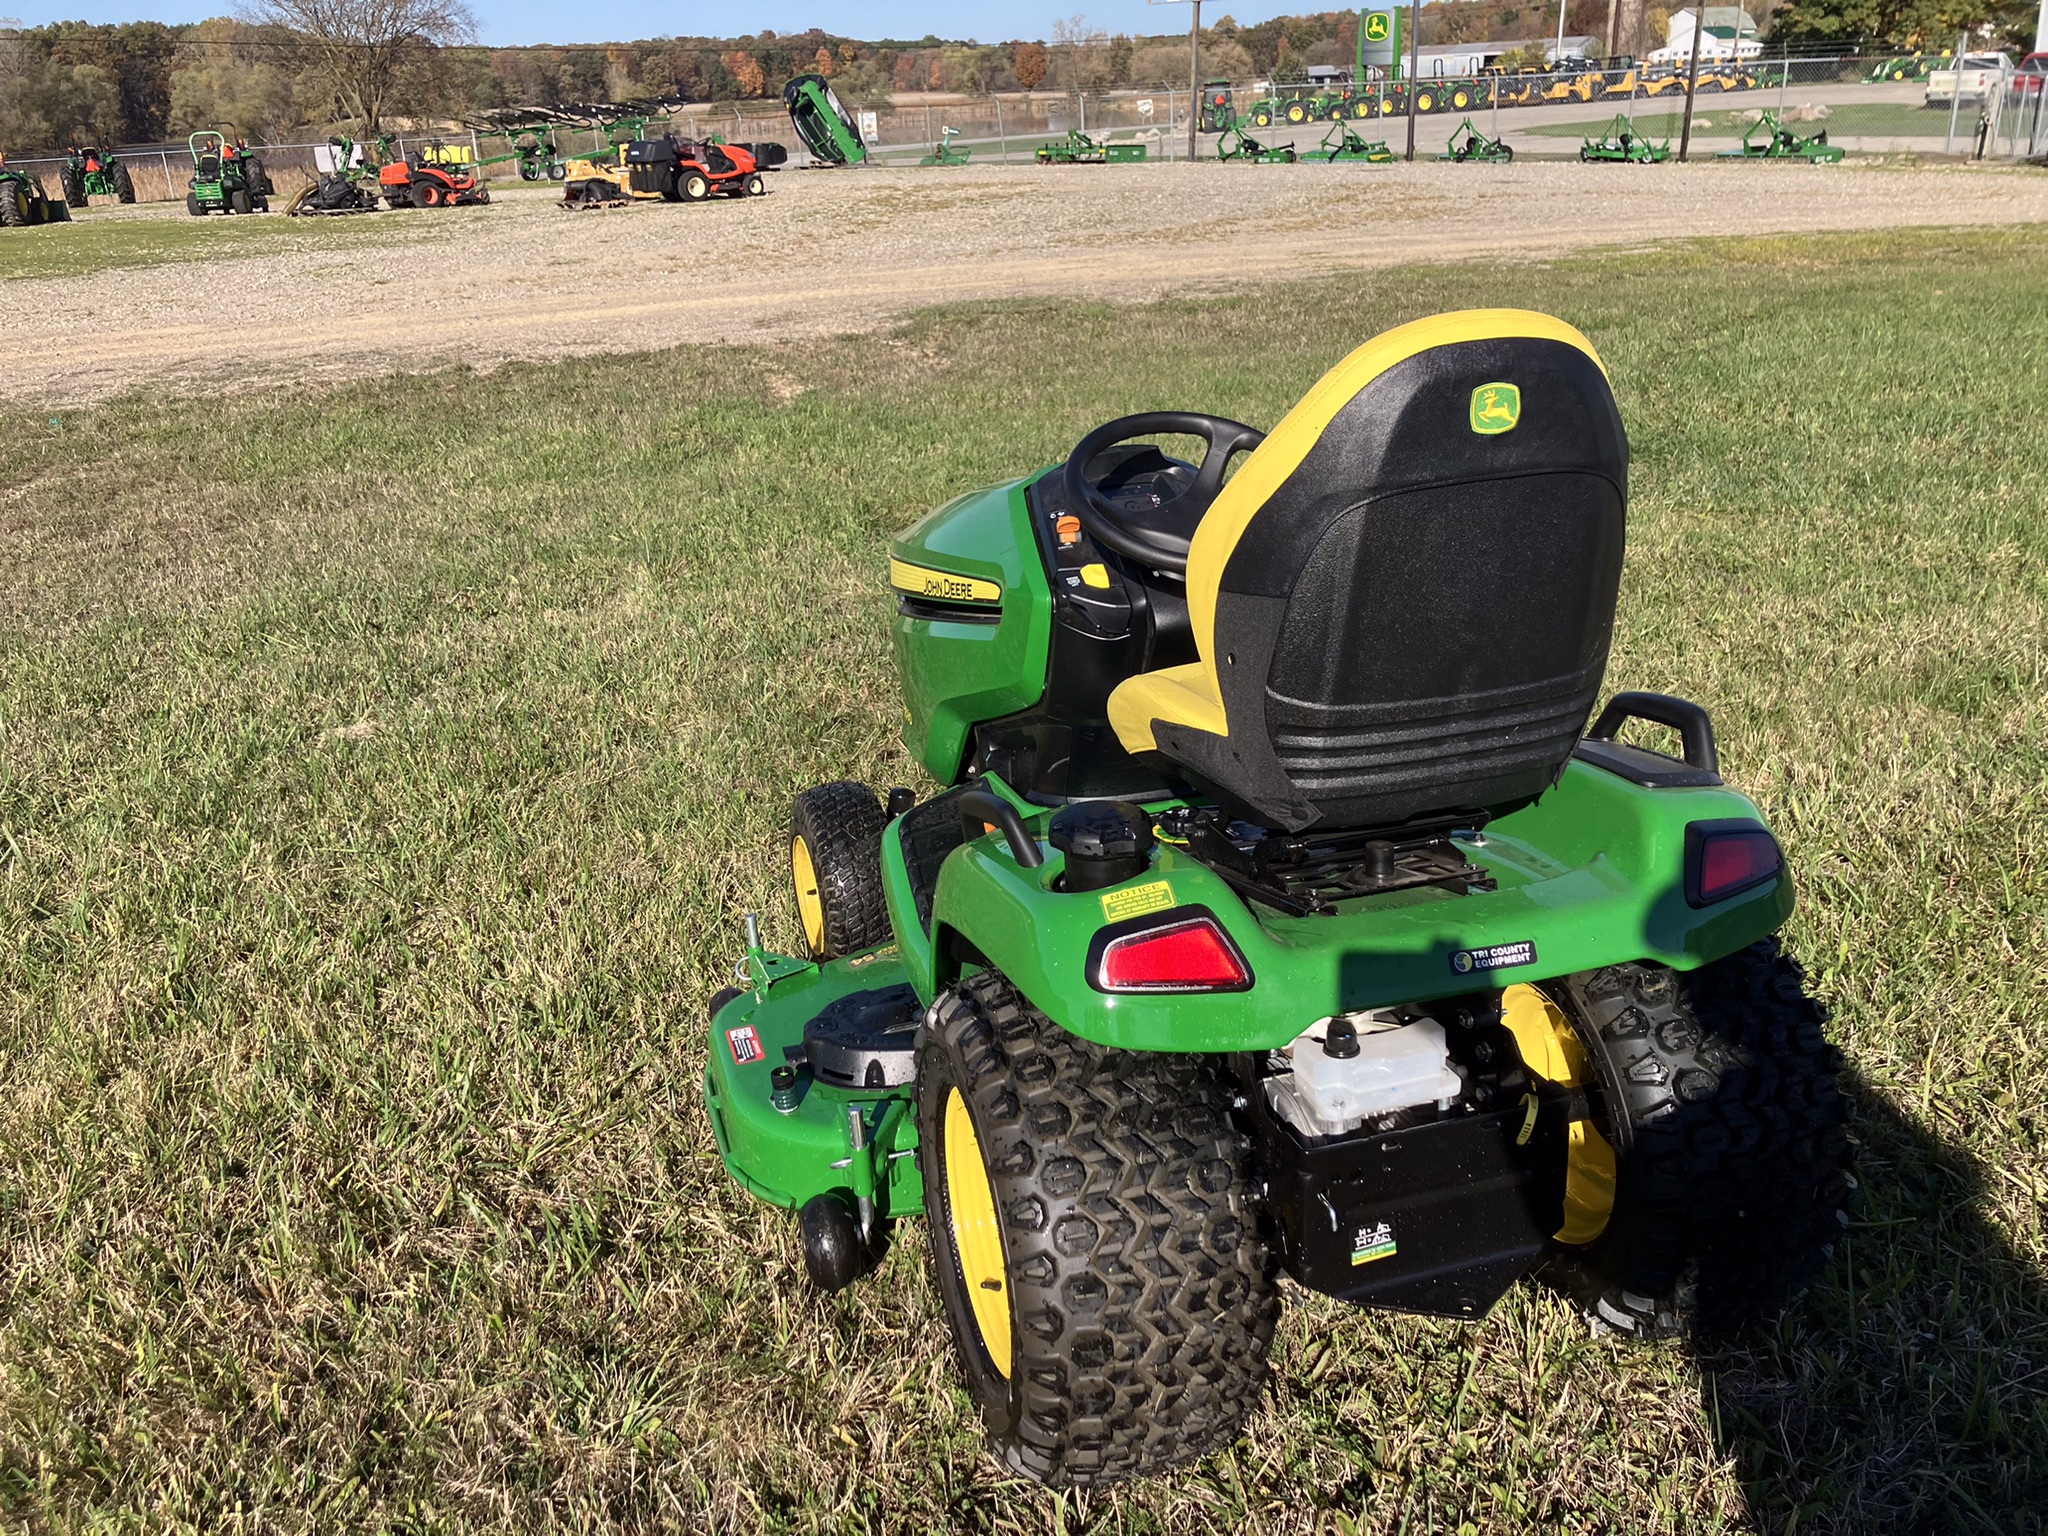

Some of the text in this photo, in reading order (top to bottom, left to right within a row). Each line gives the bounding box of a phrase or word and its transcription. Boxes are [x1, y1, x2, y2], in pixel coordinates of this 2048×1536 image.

[924, 577, 972, 597] JOHN DEERE
[1110, 884, 1160, 900] NOTICE
[1471, 943, 1530, 959] TRI COUNTY
[1475, 953, 1531, 968] EQUIPMENT
